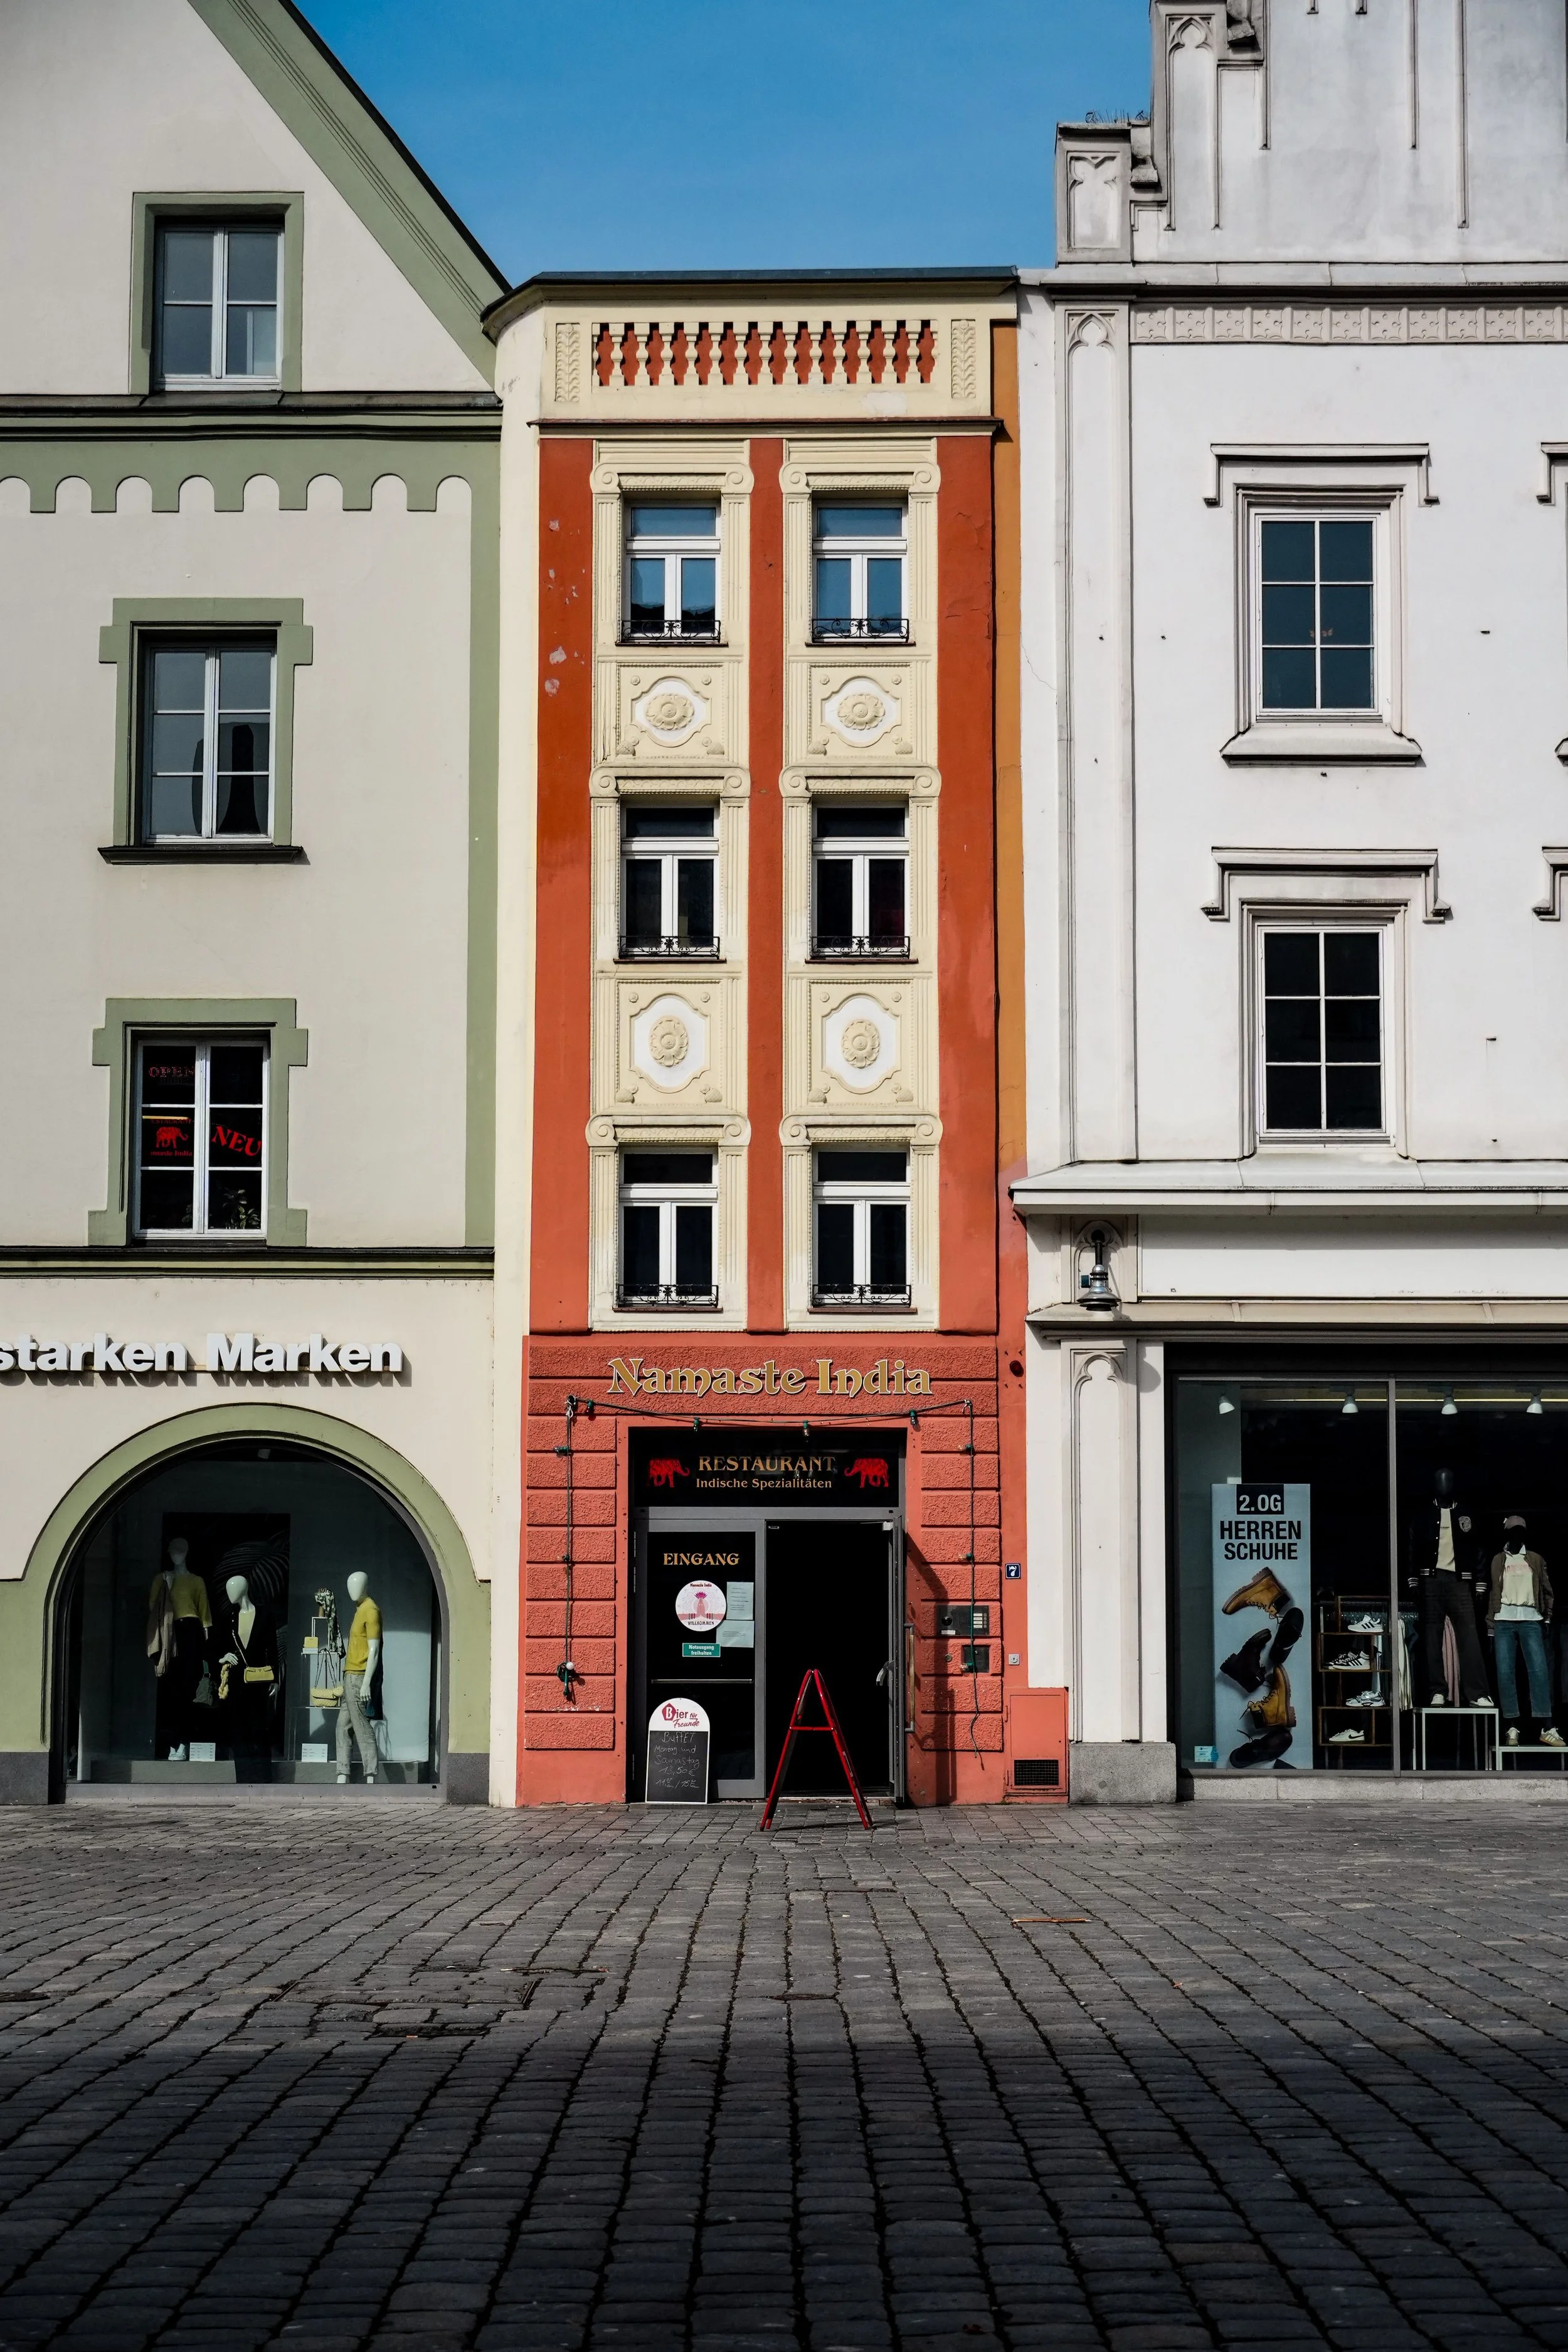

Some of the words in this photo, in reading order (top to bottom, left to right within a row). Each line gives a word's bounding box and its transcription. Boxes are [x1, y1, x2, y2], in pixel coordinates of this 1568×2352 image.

[149, 1066, 195, 1078] OPEN
[211, 1126, 262, 1157] NEU
[206, 1333, 405, 1372] Marken
[607, 1358, 807, 1397] Namaste
[816, 1359, 933, 1397] India
[699, 1456, 835, 1471] RESTAURANT
[696, 1478, 748, 1488] Indische
[752, 1477, 832, 1490] Spezialitäten
[1220, 1520, 1301, 1540] HERREN
[1224, 1542, 1298, 1560] SCHUHE
[664, 1553, 739, 1565] EINGANG
[1009, 1566, 1017, 1576] 7
[665, 1707, 689, 1719] Bier
[673, 1719, 700, 1728] Freunde
[654, 1745, 677, 1756] Montag
[681, 1745, 696, 1754] und
